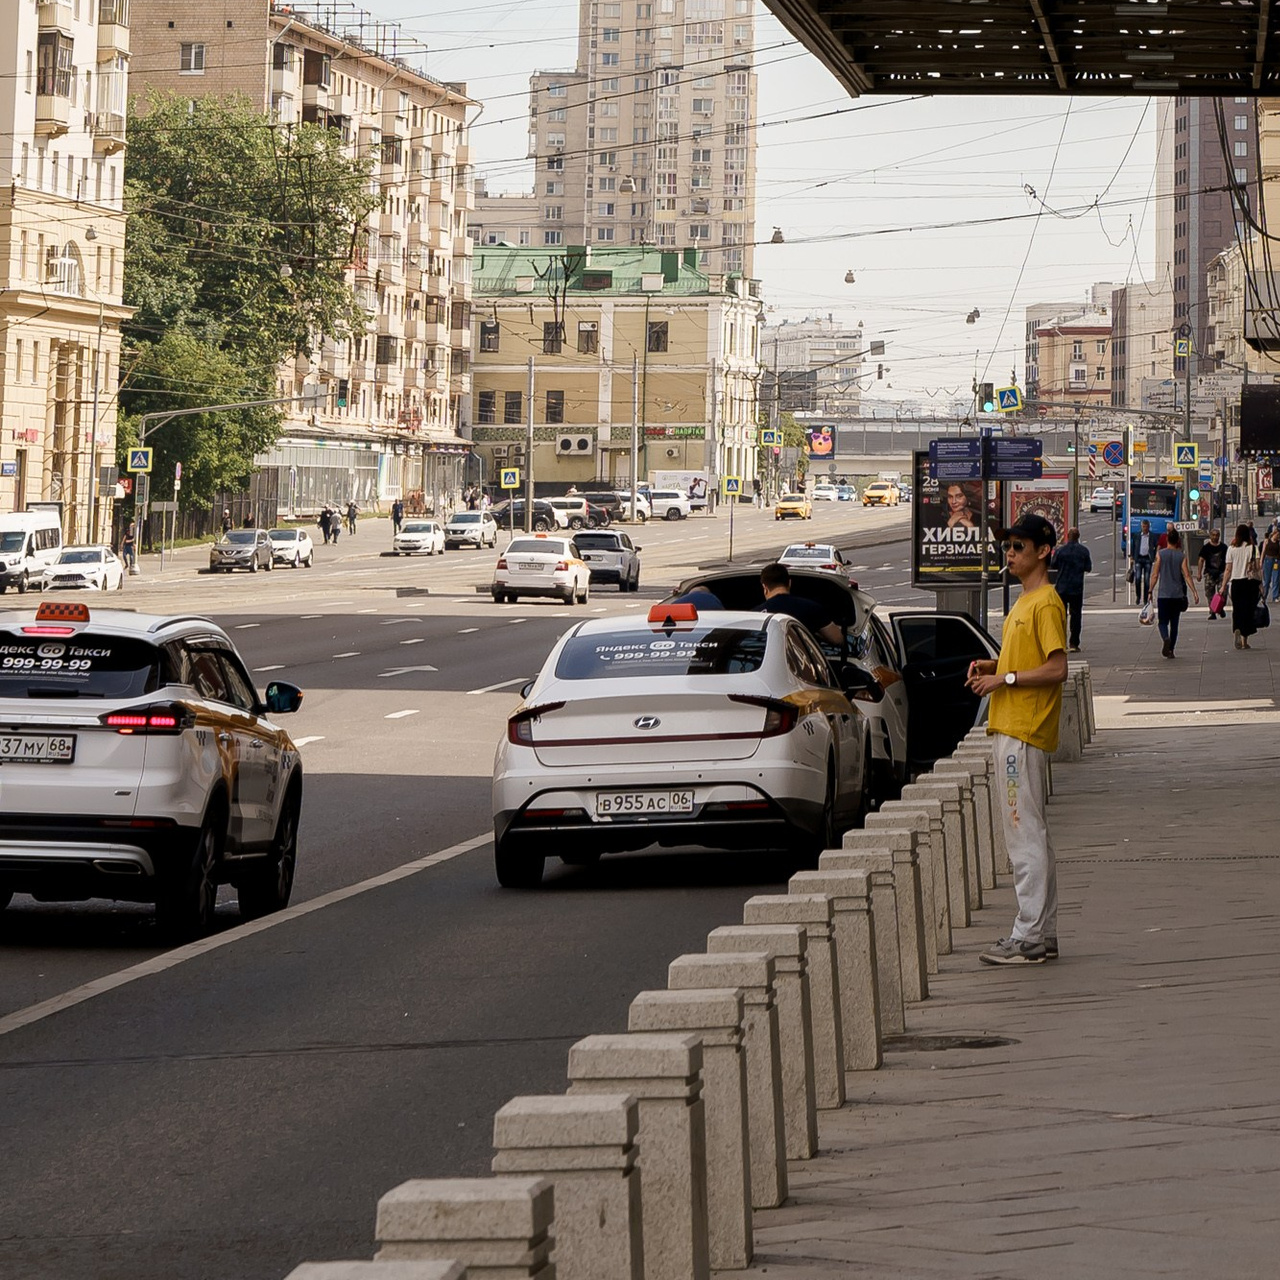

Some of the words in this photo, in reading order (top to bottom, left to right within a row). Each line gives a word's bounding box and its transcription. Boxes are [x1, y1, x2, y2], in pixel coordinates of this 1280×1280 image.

[1175, 522, 1196, 530] СТОП
[69, 646, 111, 657] Такси
[595, 643, 648, 653] Яндекс
[614, 650, 697, 660] 999-99-99
[2, 657, 92, 670] 999-99-99
[1006, 754, 1020, 807] adidas
